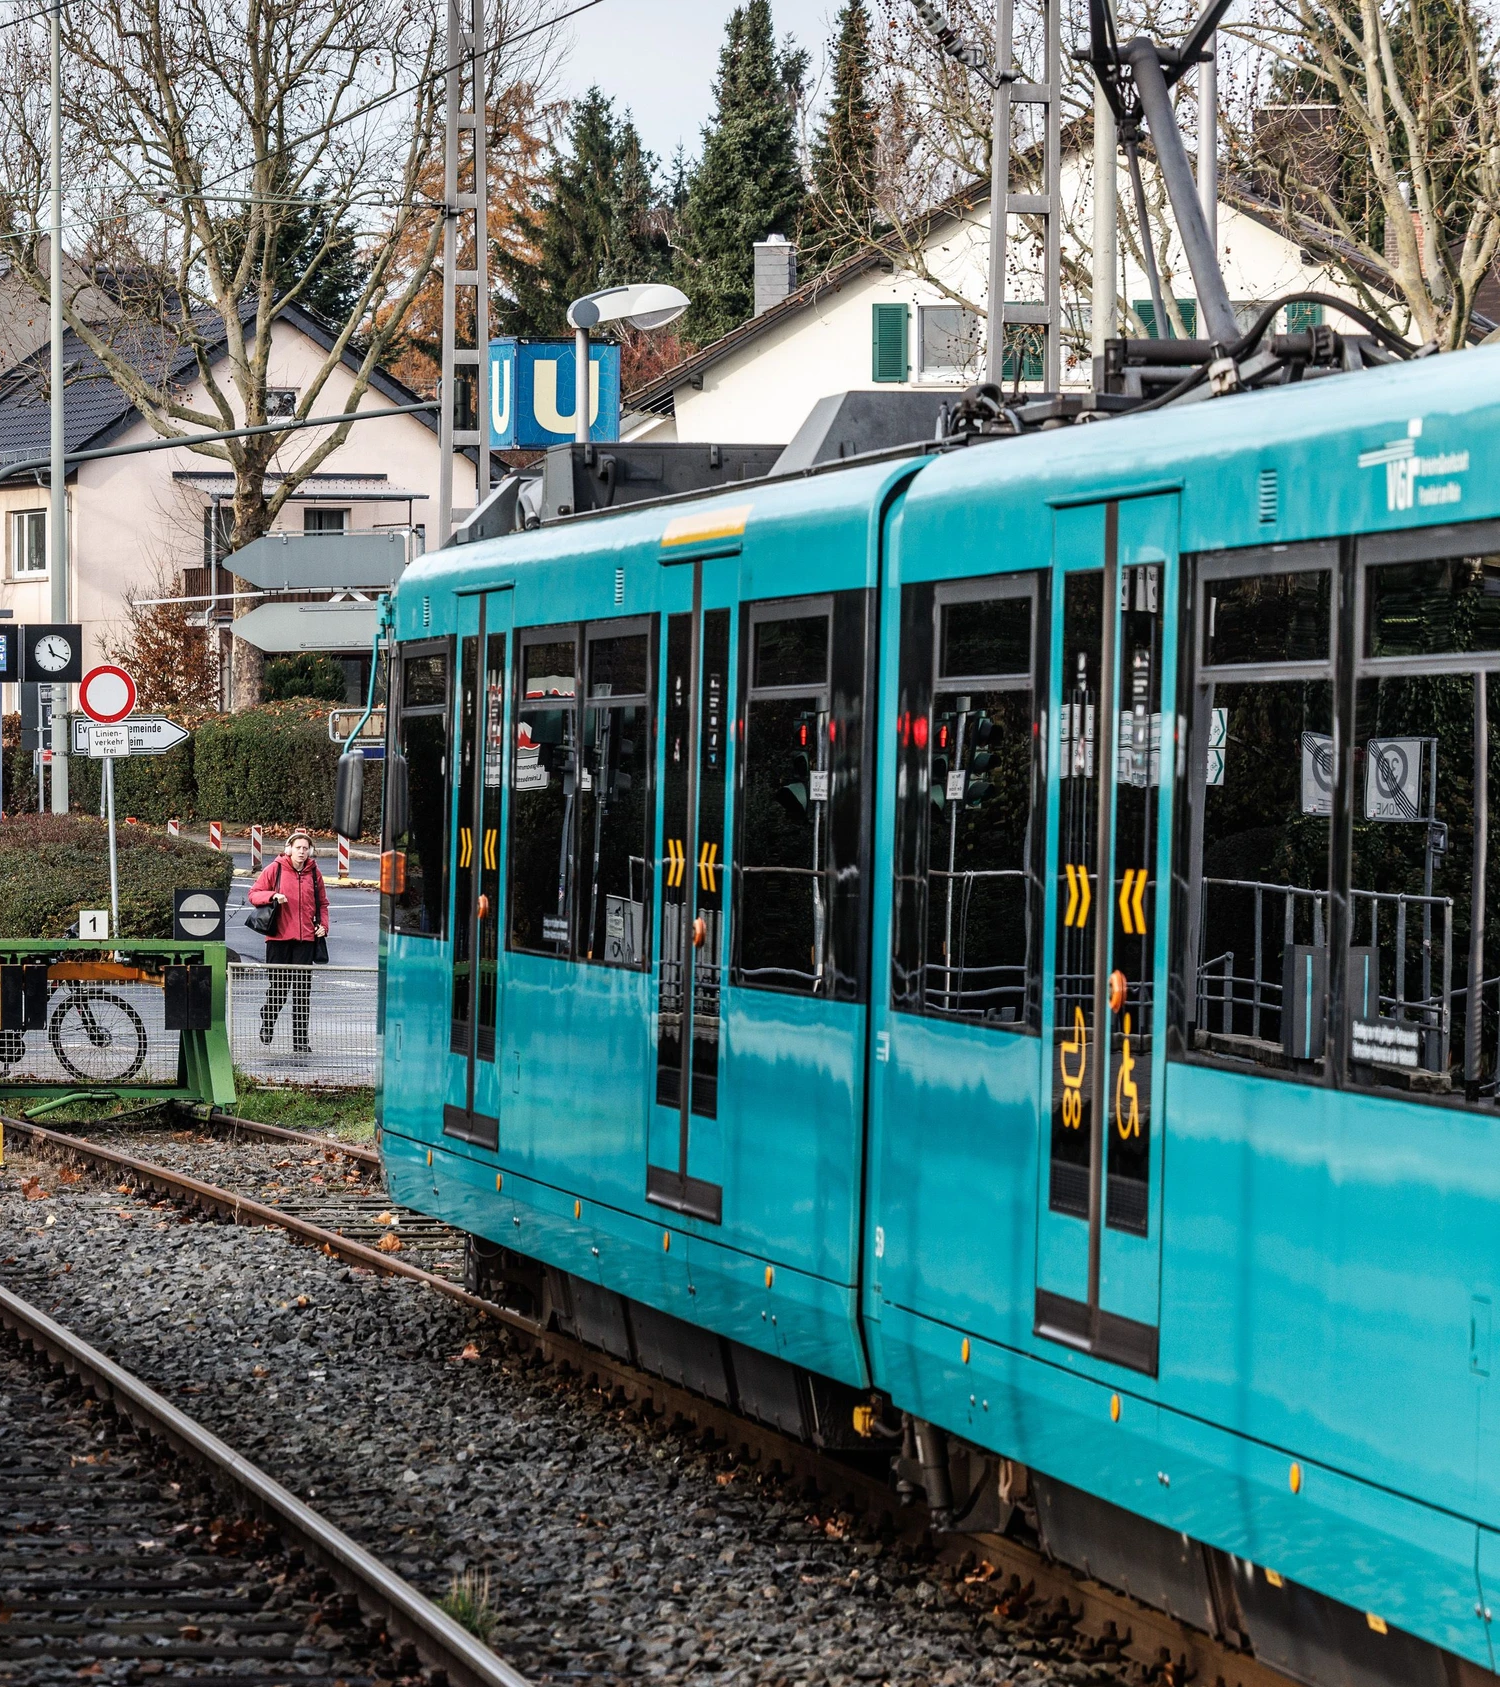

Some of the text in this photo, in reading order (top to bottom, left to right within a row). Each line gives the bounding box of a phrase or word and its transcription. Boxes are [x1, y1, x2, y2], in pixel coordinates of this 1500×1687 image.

[492, 360, 510, 435] U
[533, 359, 600, 434] U
[94, 738, 124, 747] verkehr
[95, 730, 123, 738] Linien-
[88, 916, 97, 933] 1
